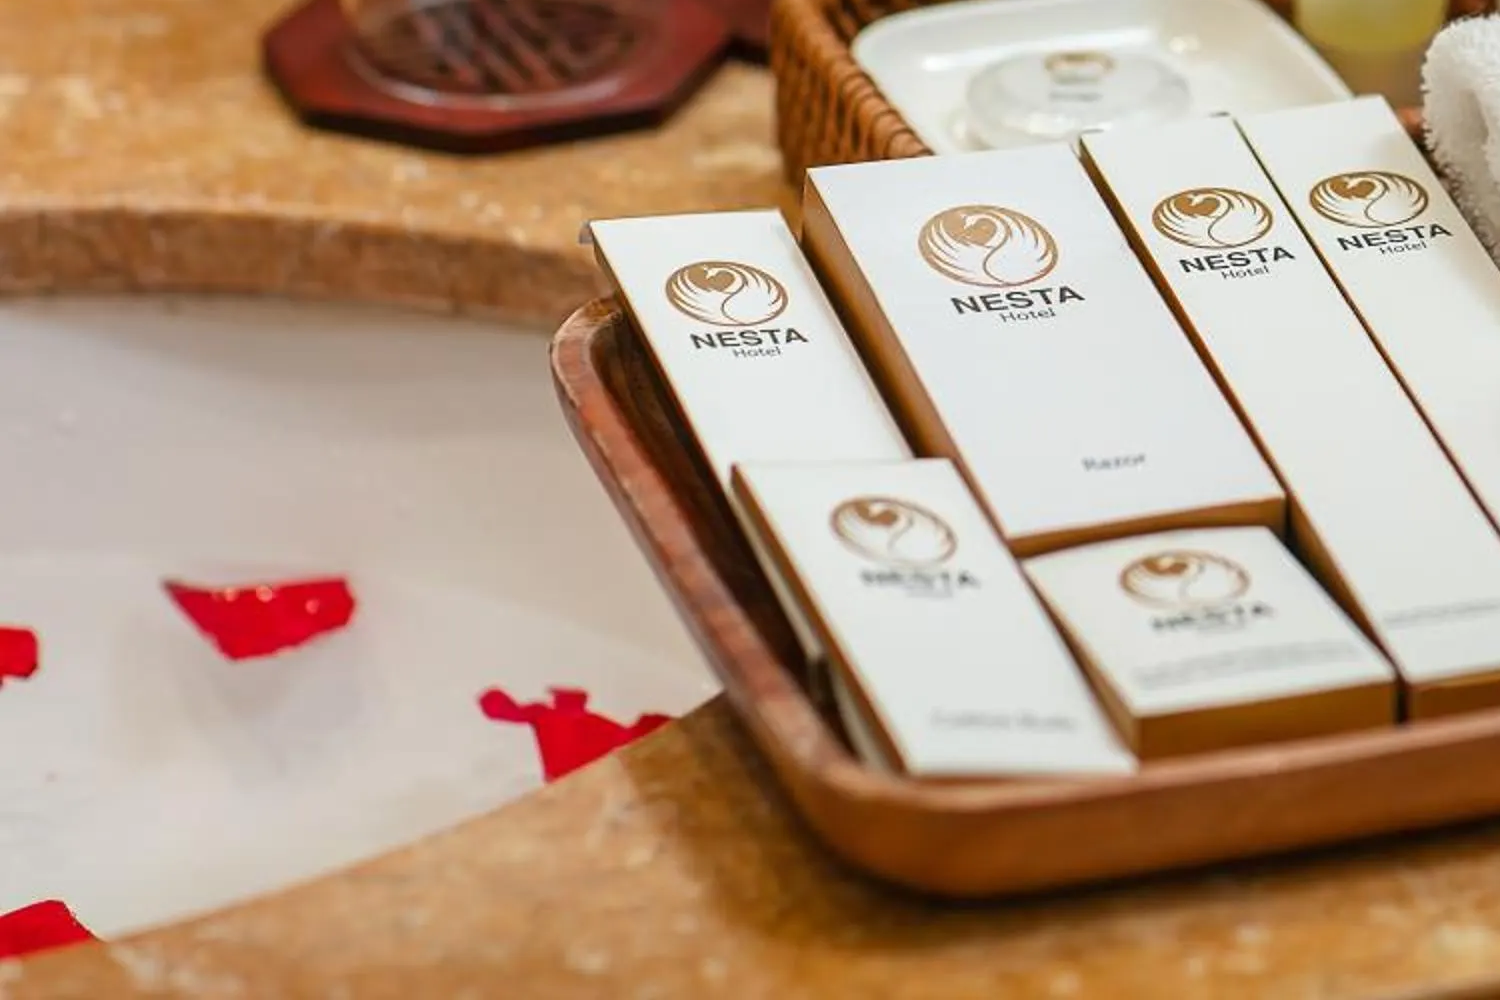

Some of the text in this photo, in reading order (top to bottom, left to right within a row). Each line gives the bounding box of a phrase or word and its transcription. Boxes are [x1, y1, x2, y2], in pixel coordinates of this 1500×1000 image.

[1337, 223, 1453, 250] NESTA
[1379, 240, 1427, 256] Hotel
[1179, 246, 1295, 273] NESTA
[1221, 264, 1270, 280] Hotel
[950, 285, 1085, 314] NESTA
[1000, 307, 1056, 323] Hotel
[690, 328, 808, 349] NESTA
[734, 347, 781, 358] Hotel
